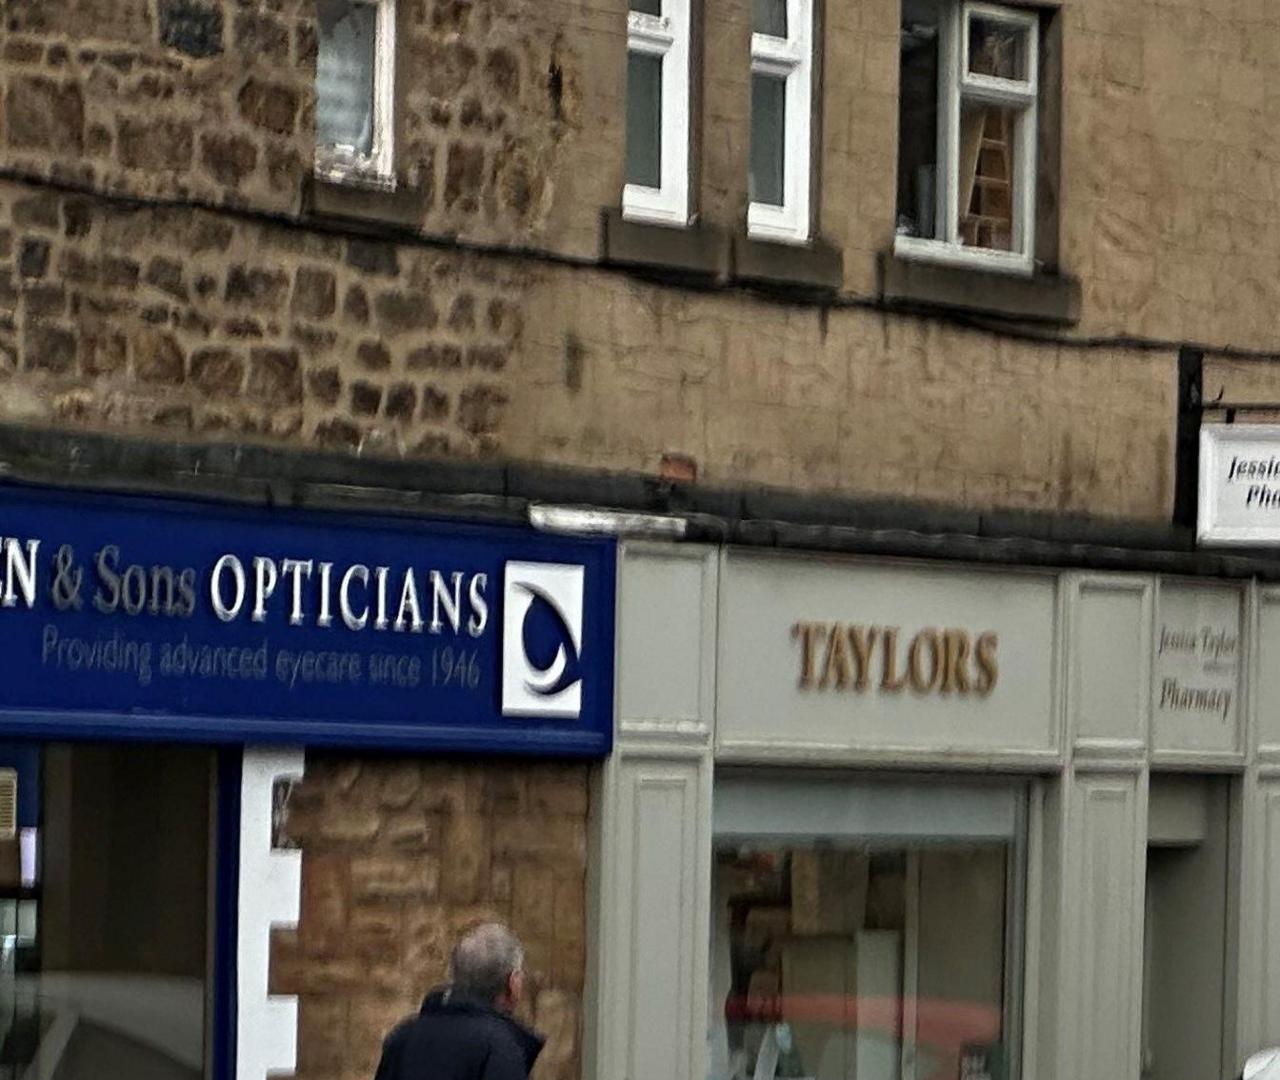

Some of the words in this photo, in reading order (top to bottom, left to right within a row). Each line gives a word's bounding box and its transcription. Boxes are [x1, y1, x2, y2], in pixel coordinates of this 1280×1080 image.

[0, 537, 41, 608] N
[52, 544, 82, 608] &
[94, 544, 197, 616] Sons
[209, 554, 488, 637] OPTICIANS
[42, 623, 151, 685] Providing
[159, 632, 268, 680] advanced
[275, 642, 363, 688] eyecare
[369, 643, 421, 685] since
[431, 645, 481, 688] 1946
[792, 620, 1000, 697] TAYLORS
[1159, 677, 1232, 722] Pharmacy
